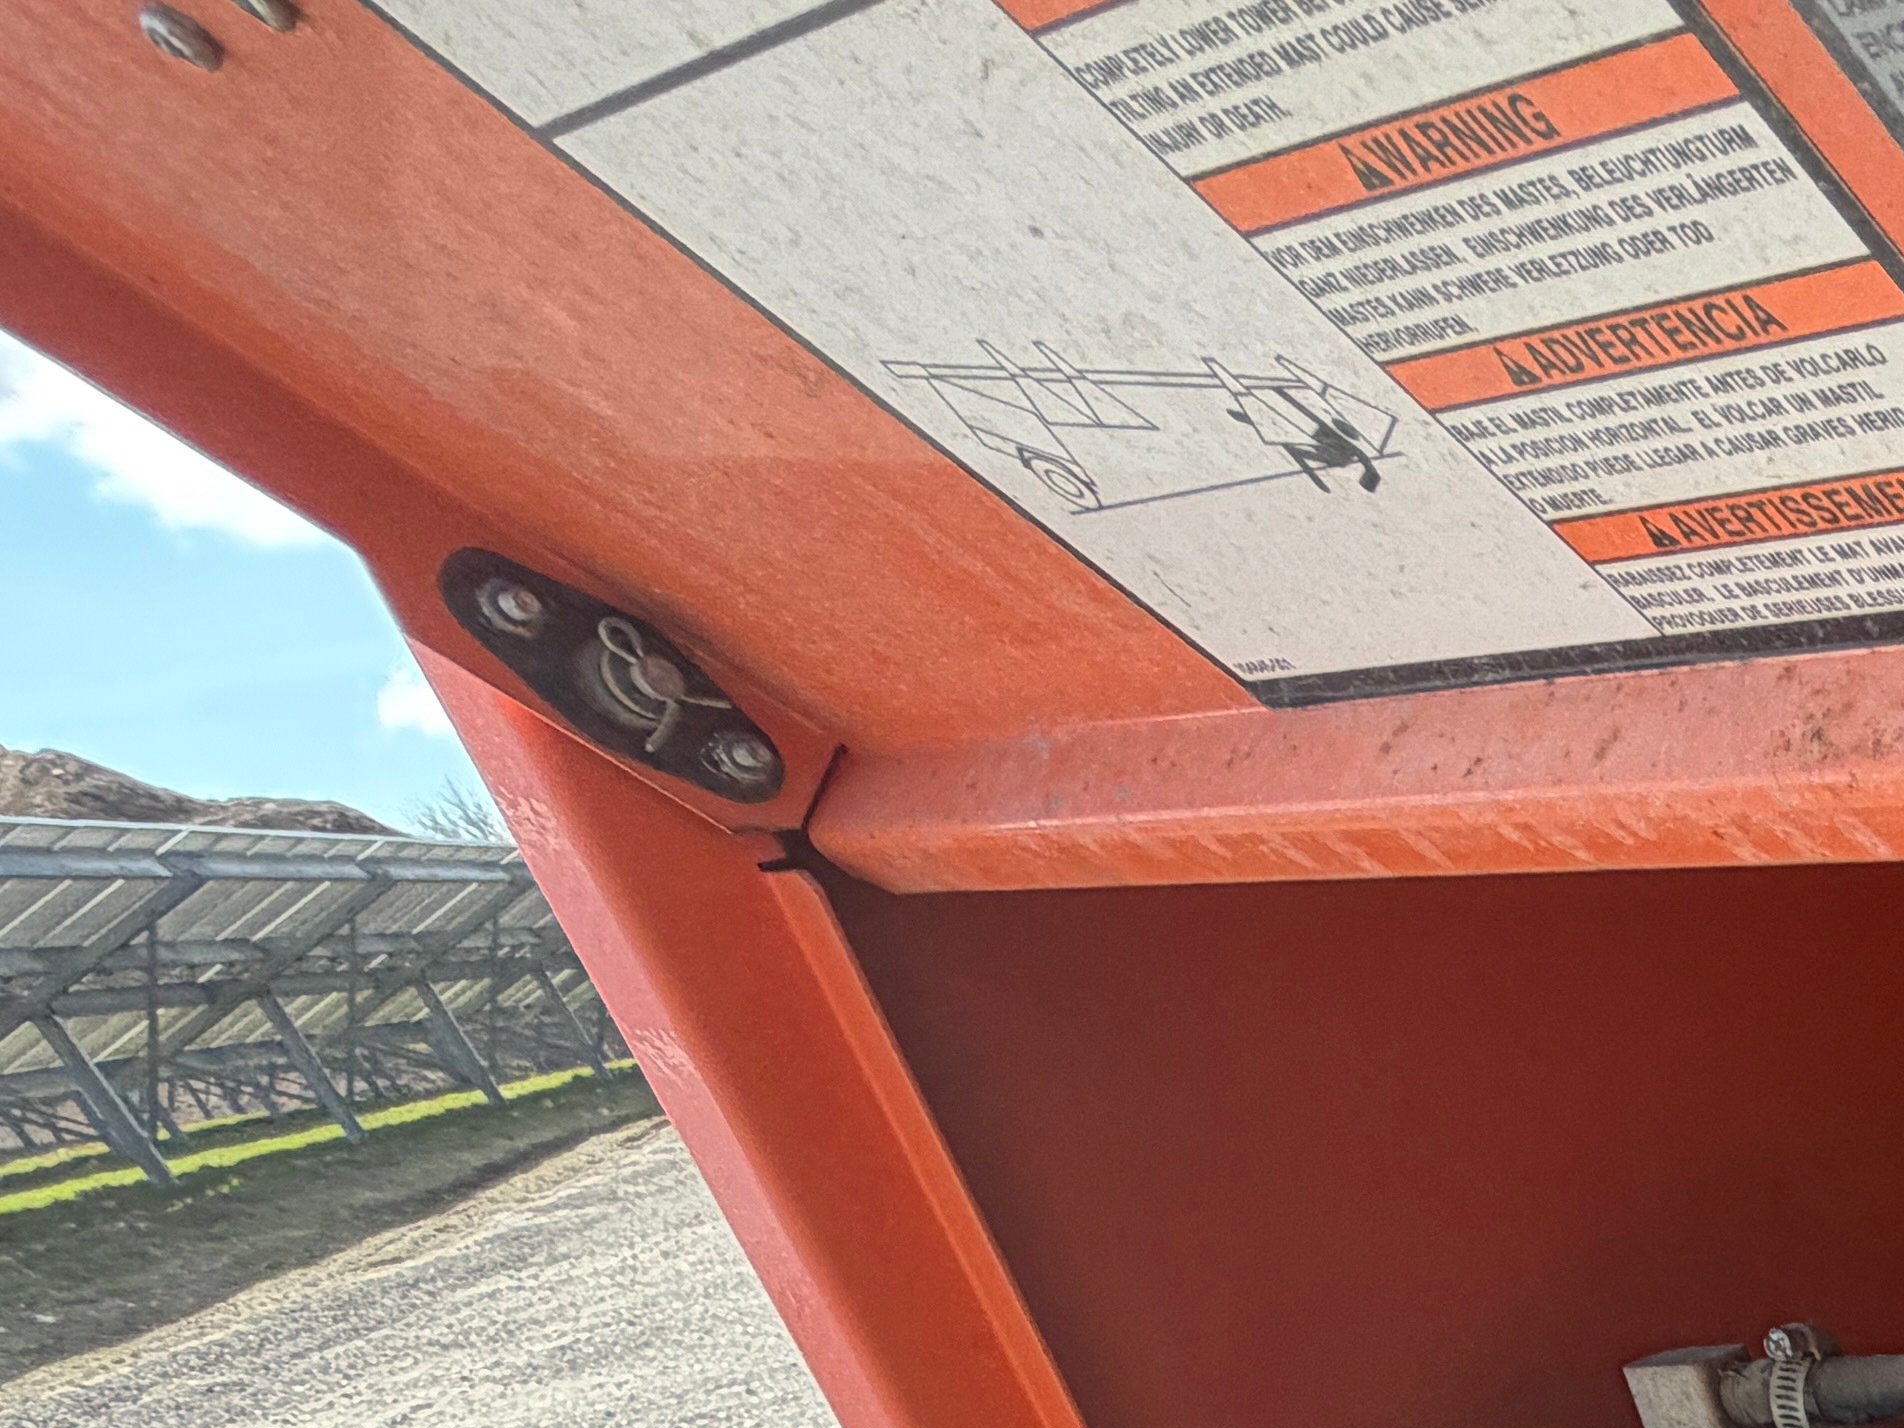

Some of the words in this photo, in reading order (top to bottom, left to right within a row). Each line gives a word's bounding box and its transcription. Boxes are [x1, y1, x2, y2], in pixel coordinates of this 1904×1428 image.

[1074, 33, 1181, 90] COMPLETELY
[1171, 16, 1239, 56] LOWER
[1227, 0, 1300, 34] TOWER
[1108, 85, 1178, 123] TILTING
[1168, 76, 1203, 103] AN
[1189, 50, 1284, 97] EXTENDED
[1272, 32, 1329, 71] MAST
[1321, 13, 1390, 53] COULD
[1143, 118, 1208, 155] INJURY
[1199, 112, 1234, 140] OR
[1220, 94, 1294, 131] DEATH.
[1361, 92, 1561, 182] WARNING
[1268, 240, 1311, 270] VOR
[1298, 232, 1342, 262] DEM
[1333, 200, 1467, 254] EINSCHWENKEN
[1455, 191, 1501, 222] DES
[1492, 173, 1582, 211] MASTES,
[1299, 271, 1348, 299] GANZ
[1461, 204, 1619, 260] EINSCHWENKUNG
[1606, 194, 1656, 225] DES
[1645, 156, 1798, 212] VERLÄNGERTEN
[1325, 297, 1396, 328] MASTES
[1392, 286, 1441, 312] KANN
[1432, 267, 1519, 304] SCHWERE
[1507, 241, 1625, 285] VERLETZUNG
[1617, 227, 1676, 260] ODER
[1524, 293, 1789, 378] ADVERTENCIA
[1451, 416, 1496, 443] BAJE
[1488, 416, 1518, 435] EL
[1510, 406, 1573, 432] MASTIL
[1566, 378, 1710, 422] COMPLETAMENTE
[1704, 367, 1766, 396] ANTES
[1760, 362, 1792, 385] DE
[1786, 342, 1888, 379] VOLCARLO
[1477, 448, 1499, 469] A
[1491, 444, 1515, 465] LA
[1511, 430, 1590, 461] POSICION
[1691, 409, 1720, 430] EL
[1714, 397, 1789, 427] VOLCAR
[1784, 391, 1817, 414] UN
[1812, 380, 1885, 408] MASTIL
[1502, 460, 1591, 491] EXTENDIDO
[1583, 453, 1644, 479] PUEDE
[1637, 440, 1707, 470] LLEGAR
[1700, 439, 1719, 459] A
[1713, 429, 1789, 458] CAUSAR
[1783, 415, 1857, 446] GRAVES
[1527, 497, 1548, 515] O
[1712, 581, 1739, 600] LE
[1734, 567, 1850, 597] BASCULEMENT
[1806, 545, 1836, 563] LE
[1740, 604, 1768, 620] DE
